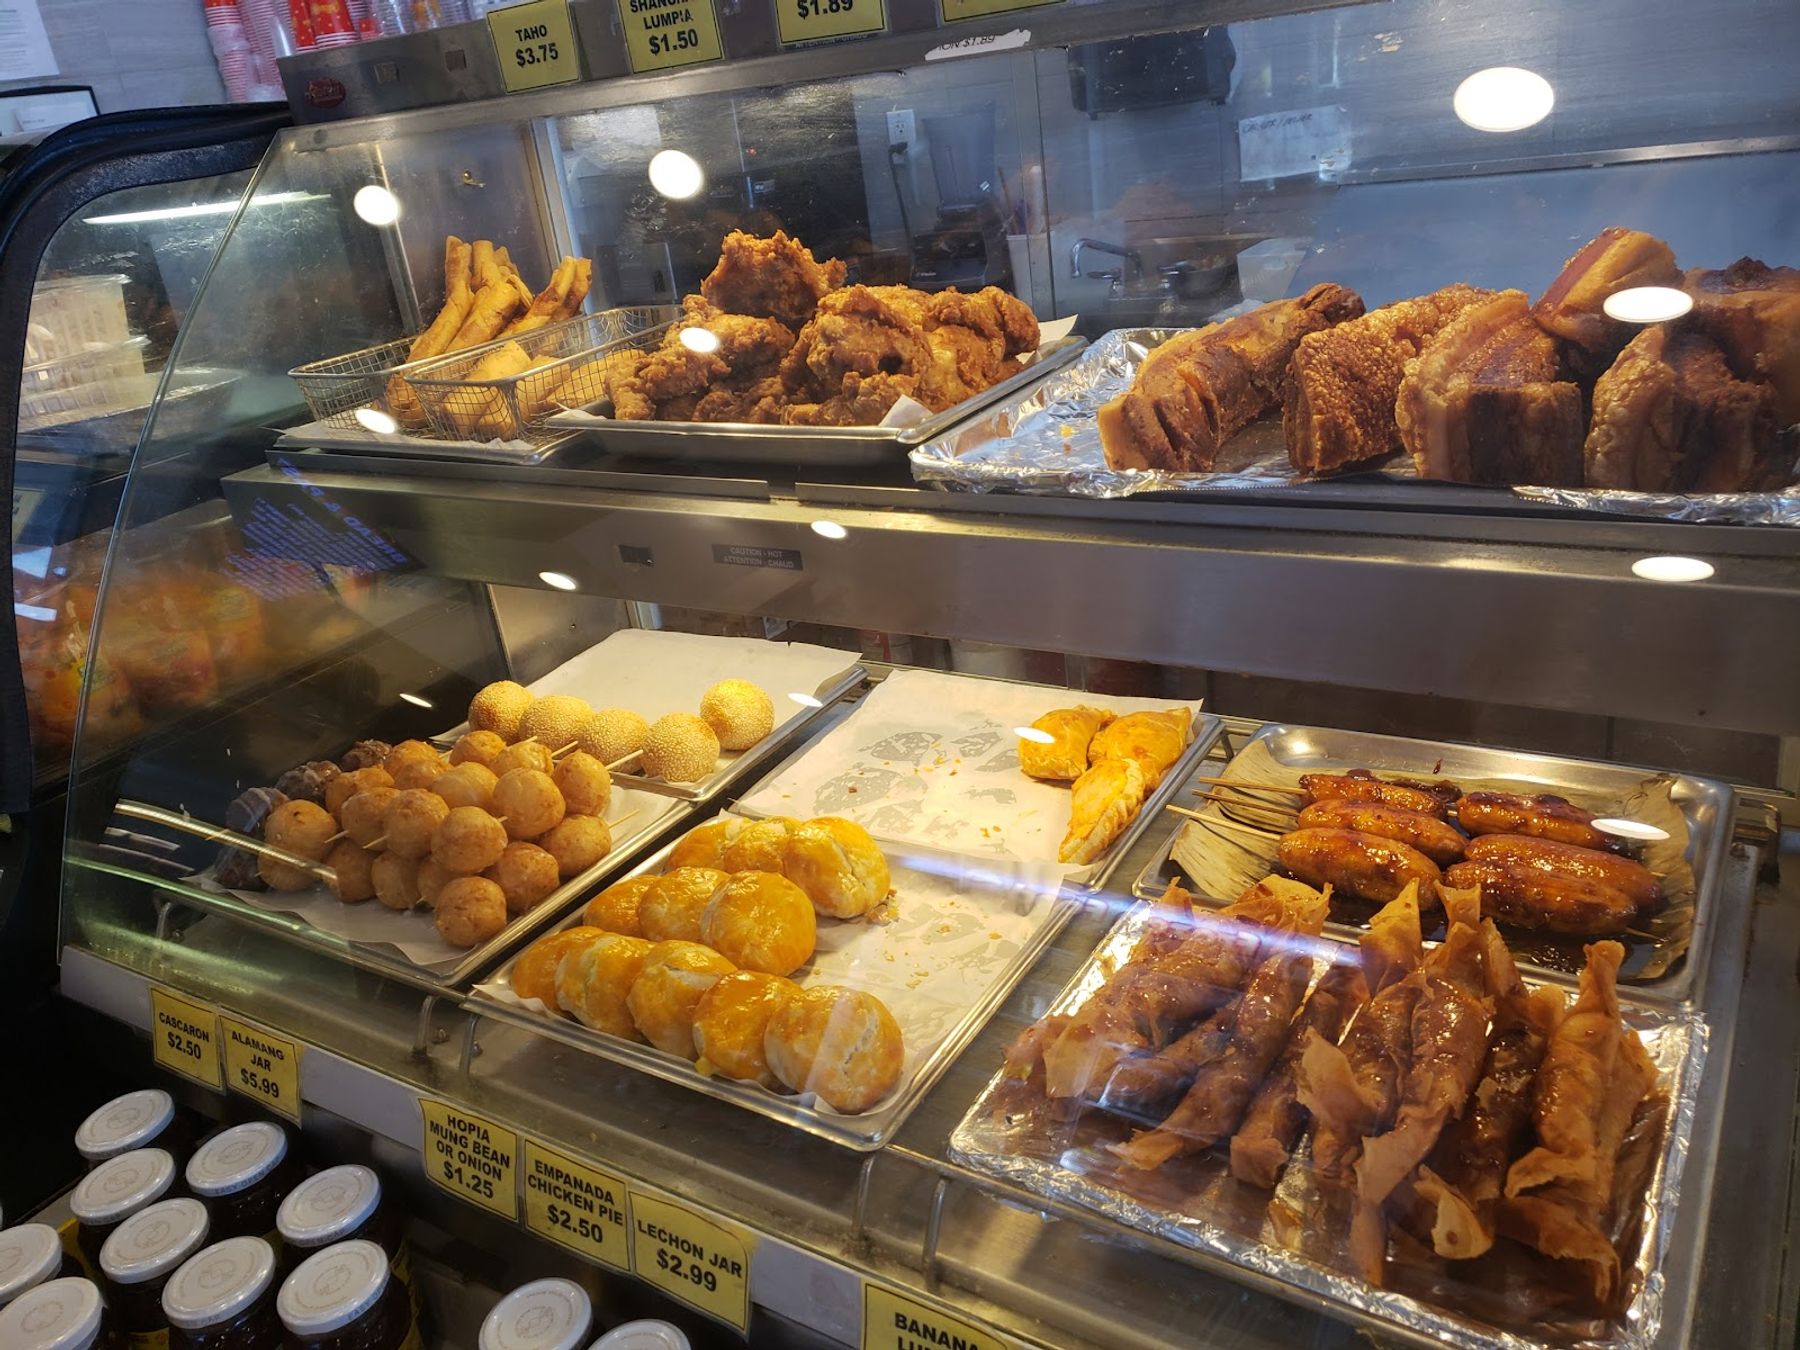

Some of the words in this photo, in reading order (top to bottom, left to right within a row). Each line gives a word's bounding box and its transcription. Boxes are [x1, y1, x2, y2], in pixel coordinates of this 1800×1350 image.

[515, 24, 547, 42] TAHO
[643, 8, 694, 30] LUMPIA
[515, 42, 559, 68] $3.75
[649, 28, 699, 56] $1.50
[159, 1012, 210, 1043] CASCARON
[167, 1031, 201, 1060] $2.50
[232, 1030, 284, 1061] ALAMANG
[250, 1054, 272, 1072] JAR
[240, 1068, 280, 1099] $5.99
[430, 1120, 469, 1149] MUNG
[472, 1141, 510, 1169] BEAN
[447, 1114, 490, 1144] HOPIA
[436, 1140, 454, 1159] OR
[457, 1151, 502, 1181] ONION
[443, 1160, 494, 1199] $1.25
[535, 1160, 615, 1206] EMPANADA
[528, 1175, 594, 1213] CHICKEN
[599, 1204, 623, 1226] PIE
[547, 1204, 603, 1244] $2.50
[637, 1220, 704, 1261] LECHON
[709, 1253, 743, 1279] JAR
[656, 1248, 718, 1292] $2.99
